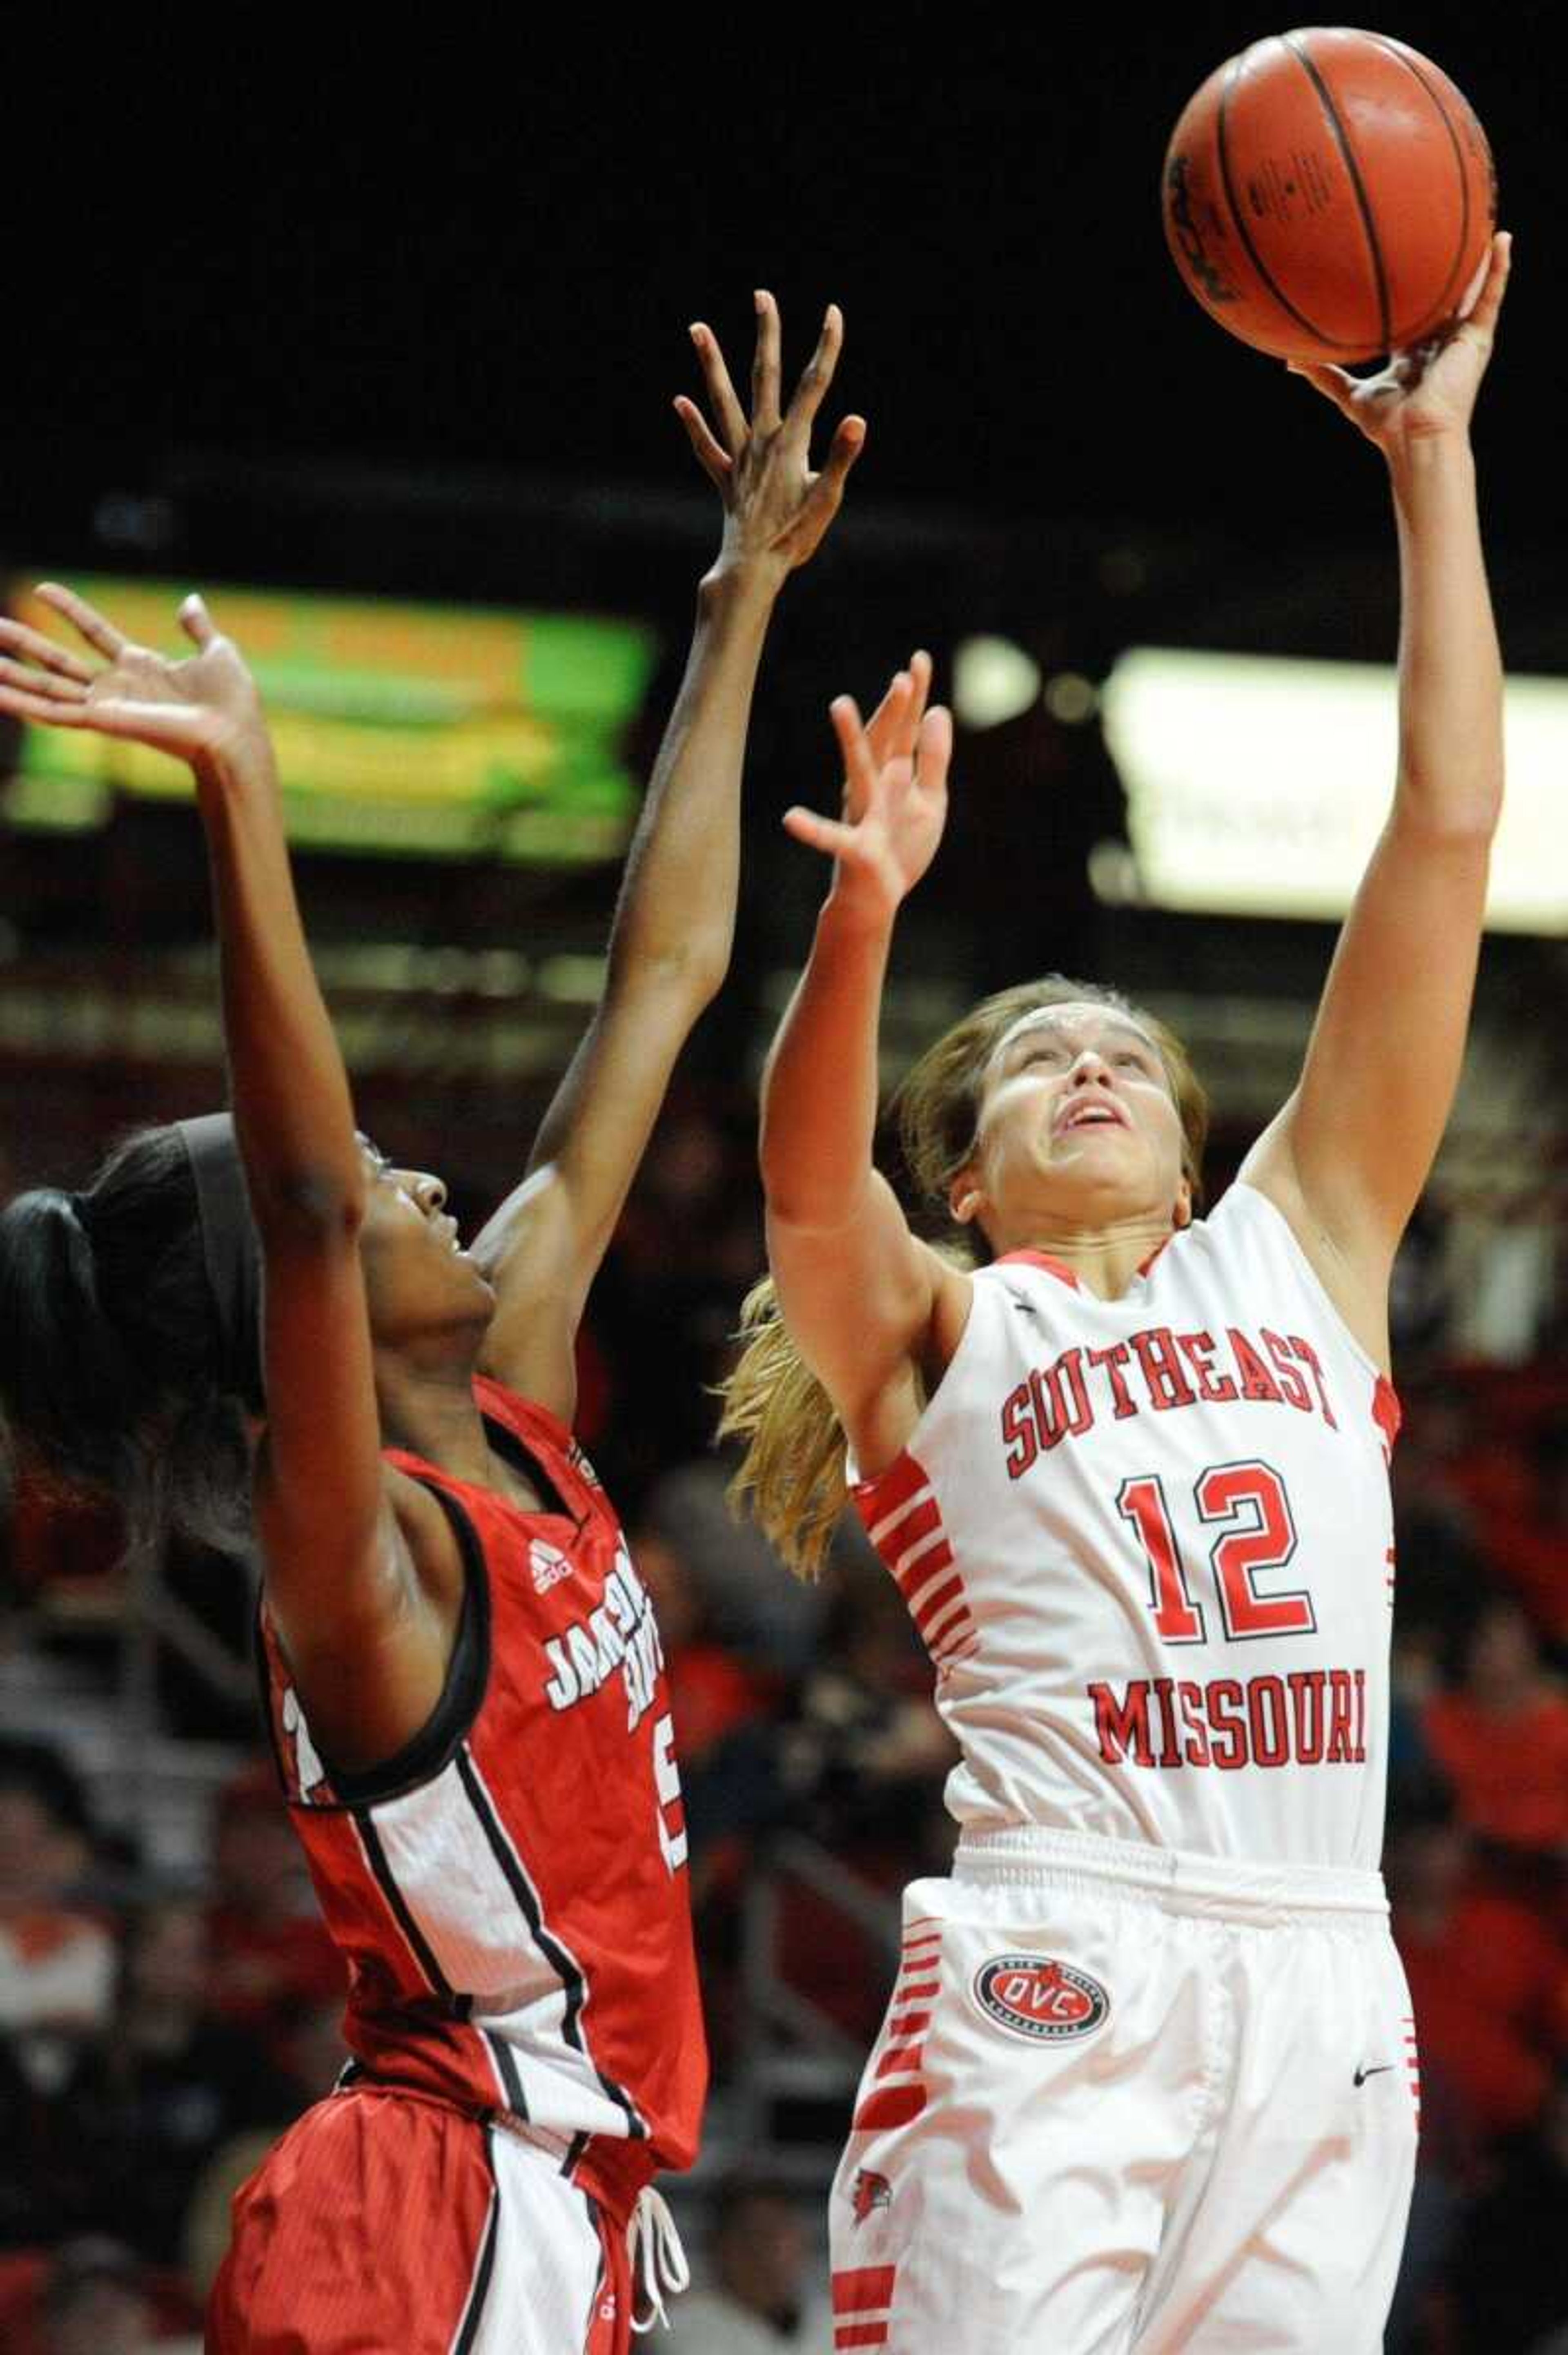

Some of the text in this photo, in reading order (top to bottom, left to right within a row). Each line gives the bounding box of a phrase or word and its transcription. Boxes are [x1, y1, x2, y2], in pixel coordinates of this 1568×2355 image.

[1002, 1326, 1338, 1479] SOUTHEAST
[1116, 1459, 1317, 1645] 12
[1087, 1669, 1365, 1770] MISSOURI
[1003, 1976, 1077, 2016] OVC
